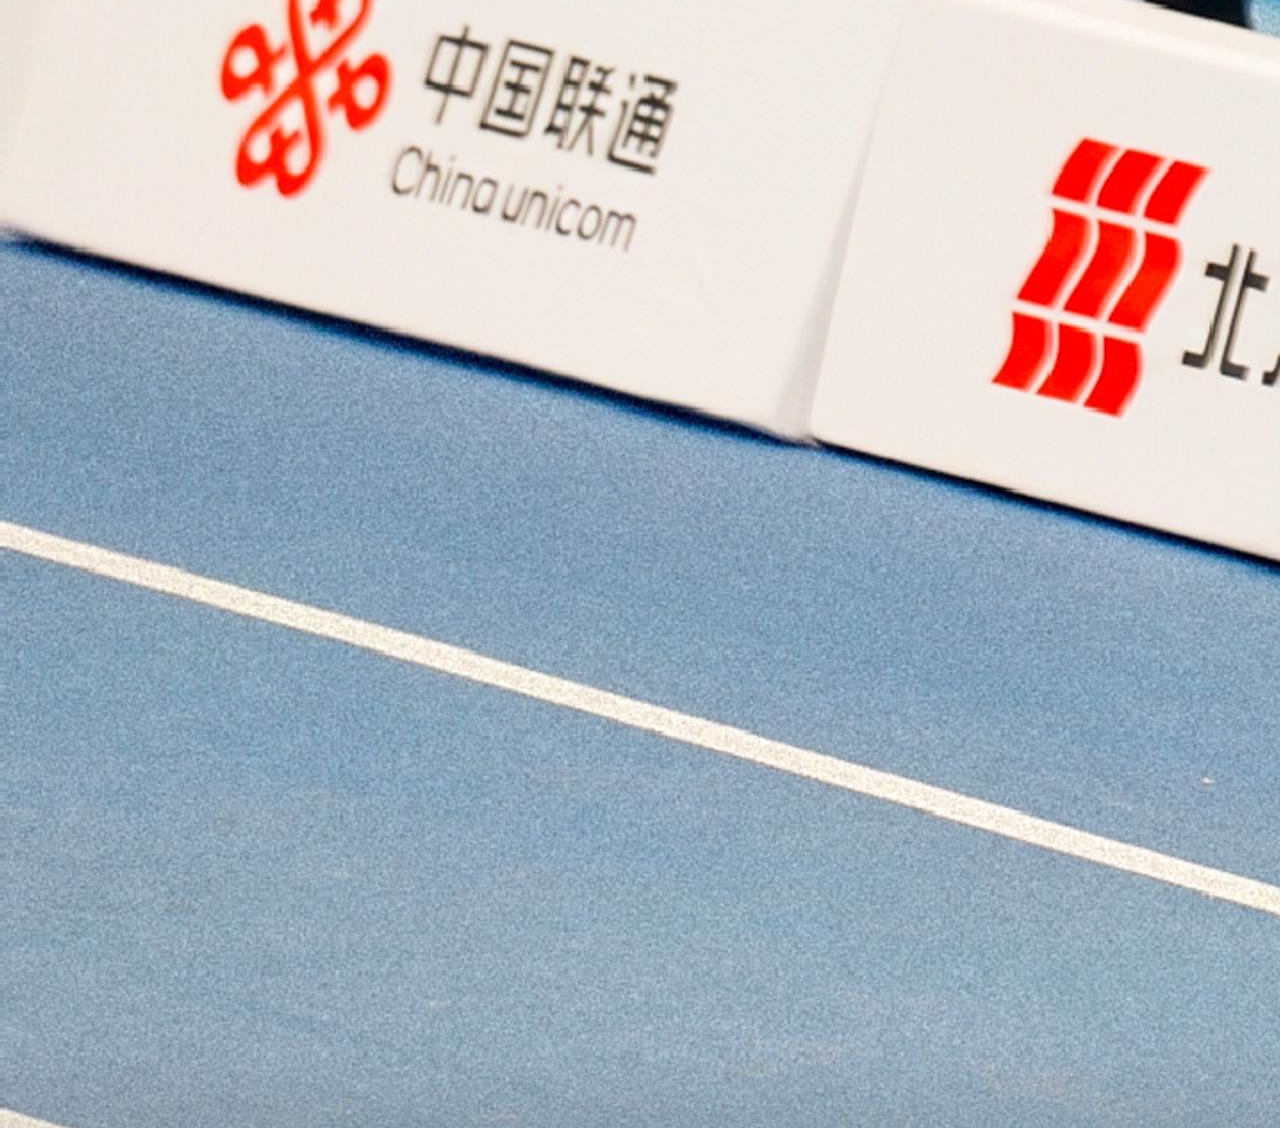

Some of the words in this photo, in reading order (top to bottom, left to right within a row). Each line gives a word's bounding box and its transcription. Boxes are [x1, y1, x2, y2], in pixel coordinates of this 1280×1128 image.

[423, 25, 678, 176] 中国联通
[390, 145, 499, 217] China
[500, 181, 638, 253] unicom
